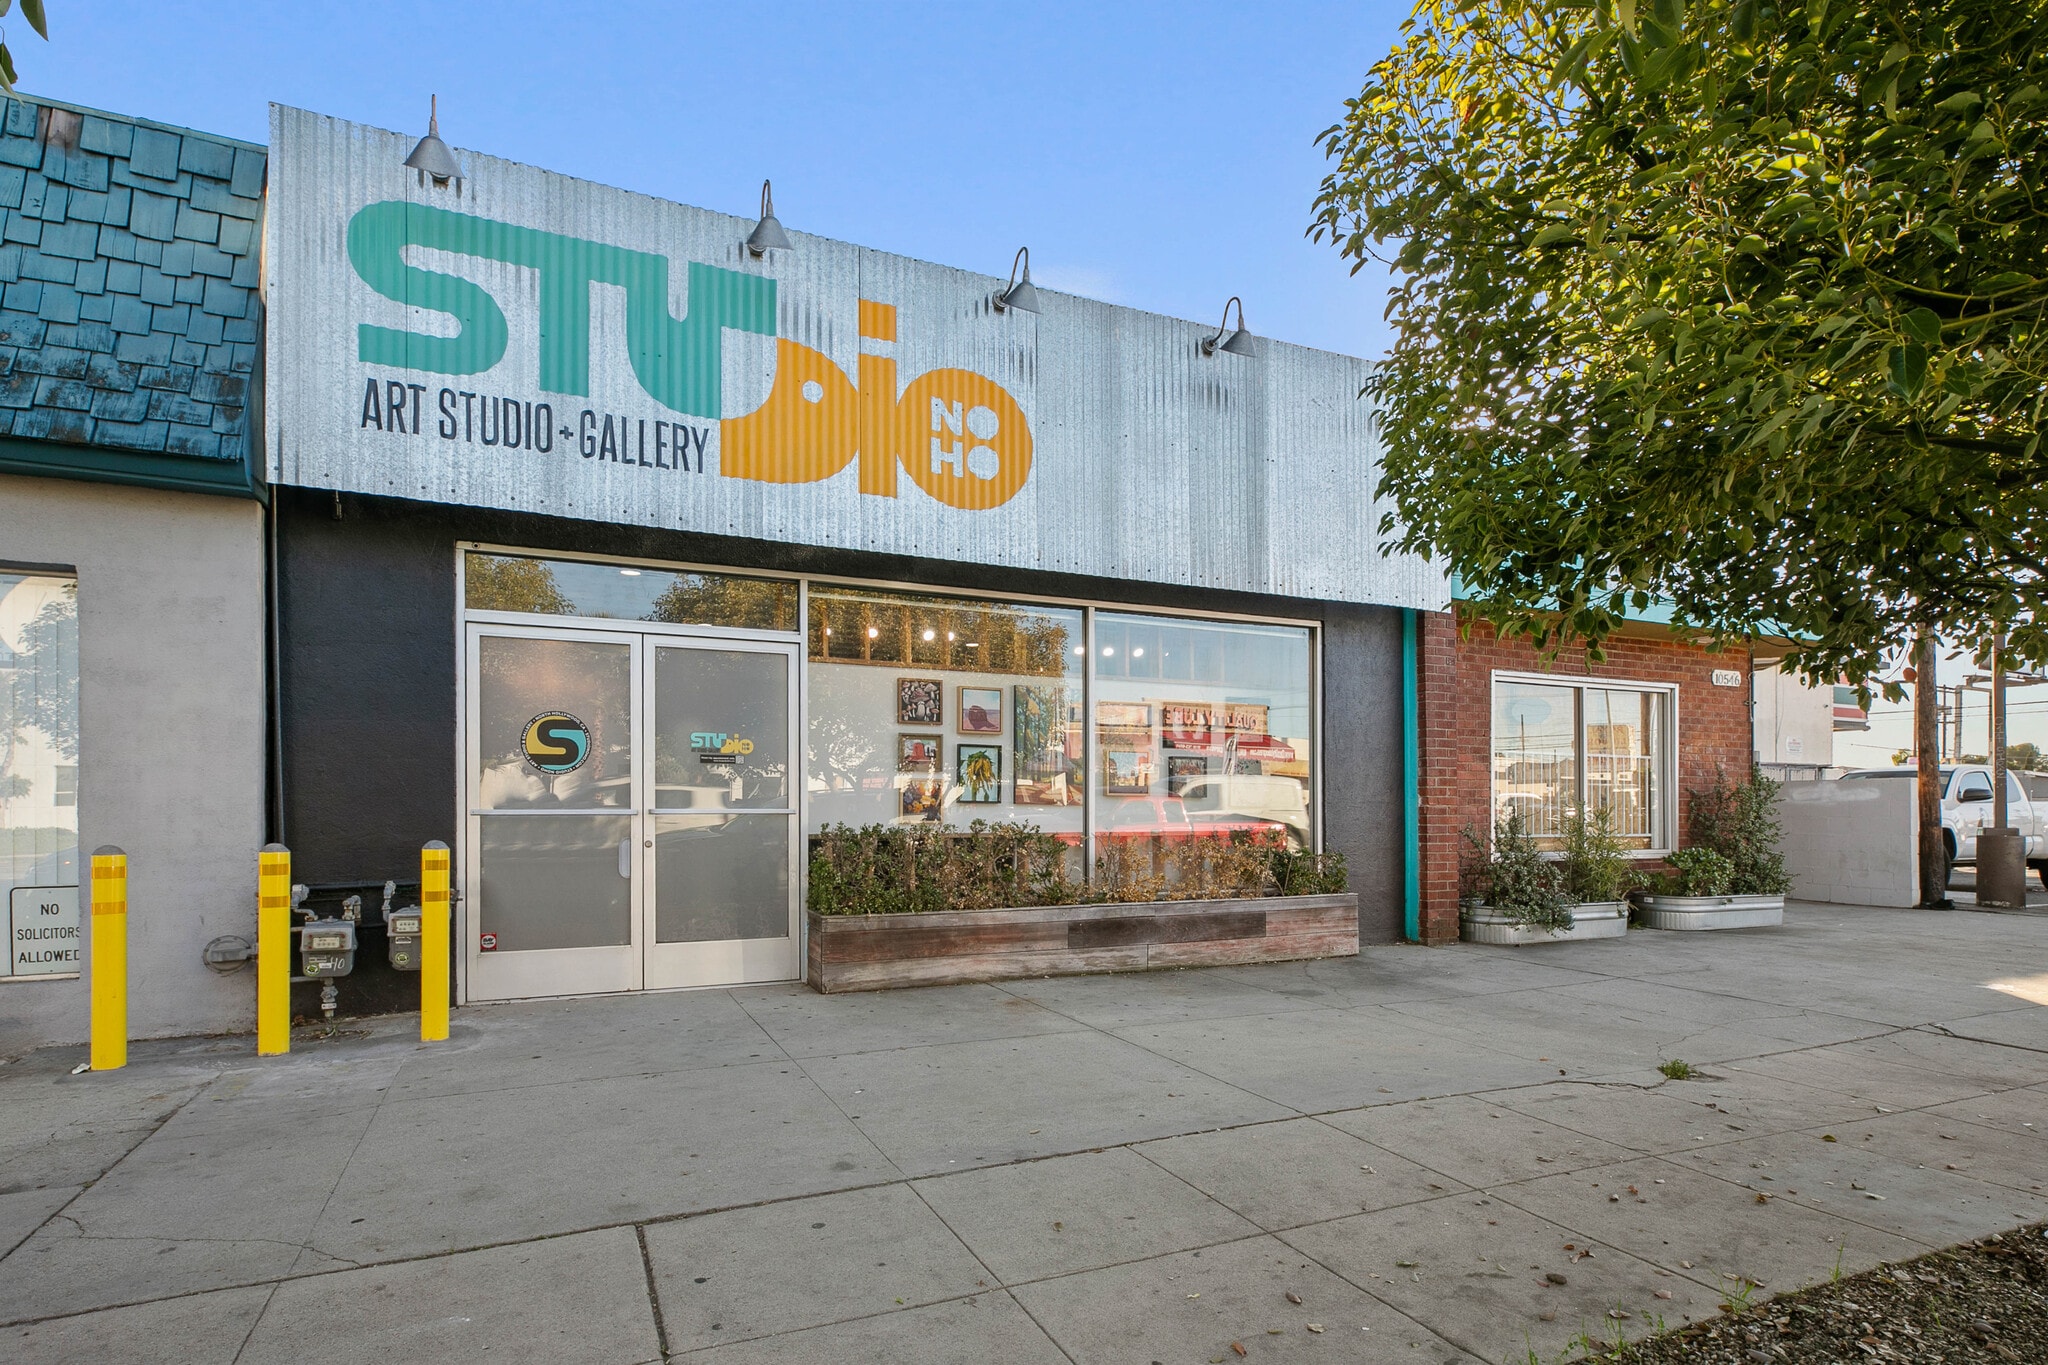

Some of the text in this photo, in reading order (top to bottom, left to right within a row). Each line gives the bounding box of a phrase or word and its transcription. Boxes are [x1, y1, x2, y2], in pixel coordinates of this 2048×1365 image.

[361, 377, 426, 435] ART
[438, 387, 553, 454] STUDIO
[579, 409, 710, 474] GALLERY
[931, 396, 999, 441] NO
[931, 436, 1000, 480] HO
[1715, 673, 1740, 686] 10546
[40, 903, 60, 916] NO
[17, 926, 80, 941] SOLICITORS
[18, 949, 80, 964] ALLOWED
